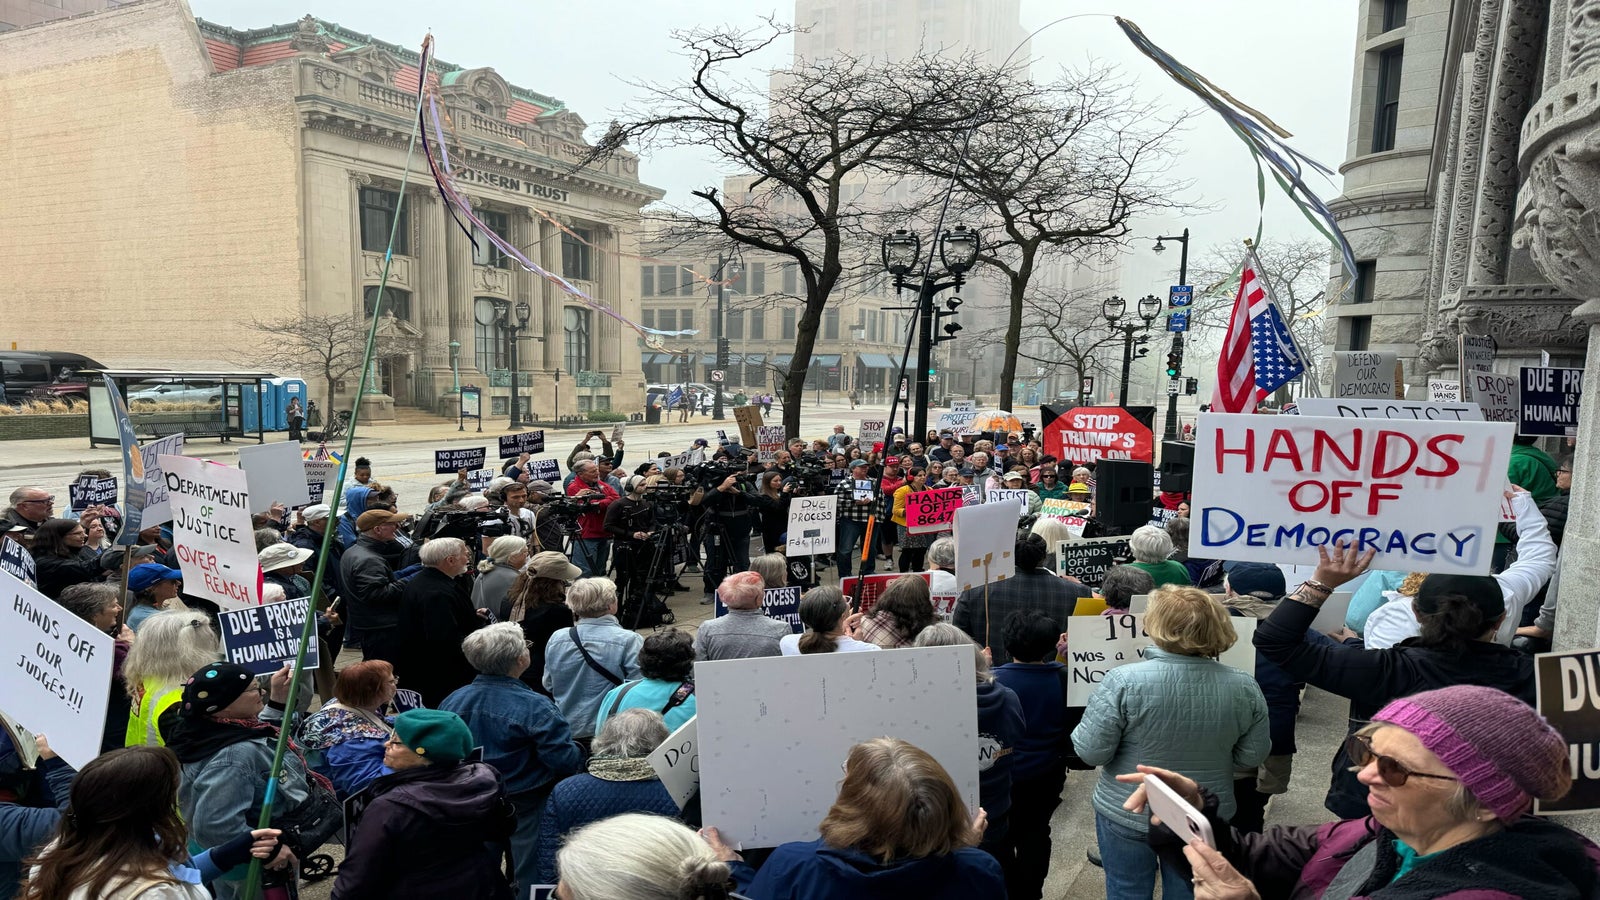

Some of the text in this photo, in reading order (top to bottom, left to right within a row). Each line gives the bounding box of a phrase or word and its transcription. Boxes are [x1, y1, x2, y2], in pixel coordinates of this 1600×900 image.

[523, 181, 569, 203] TRUST
[1172, 295, 1187, 304] 94
[1348, 353, 1382, 367] DEFEND
[1357, 367, 1378, 380] OUR
[1527, 368, 1554, 392] DUE
[1340, 383, 1391, 397] DEMOCRACY
[1477, 375, 1515, 395] DROP
[1489, 393, 1508, 405] THE
[1565, 394, 1575, 405] IS
[940, 412, 979, 421] PROTECT
[1524, 404, 1572, 422] HUMAN
[863, 421, 885, 431] STOP
[1073, 414, 1119, 430] STOP
[502, 431, 542, 445] DUE PROCESS
[1060, 429, 1135, 448] TRUMP'S
[438, 449, 483, 460] NO JUSTICE,
[501, 446, 522, 455] HUMAN
[1063, 447, 1131, 463] WAR ON
[1215, 427, 1465, 479] HANDS
[437, 461, 450, 469] NO
[530, 460, 556, 470] PROCESS
[665, 453, 692, 468] STOP
[165, 471, 248, 509] DEPARTMENT
[908, 490, 963, 506] HANDS
[1045, 499, 1089, 510] MAYDAY
[1288, 480, 1403, 516] OFF
[200, 505, 213, 519] OF
[919, 500, 957, 514] OFF!
[790, 511, 832, 523] PROCESS
[917, 511, 955, 526] 8647
[1048, 514, 1086, 526] AYDAY
[177, 507, 240, 543] JUSTICE
[1201, 507, 1476, 557] DEMOCRACY
[5, 539, 20, 558] DUE
[1068, 547, 1108, 558] HANDS
[0, 558, 25, 578] HUMAN
[1068, 557, 1089, 567] OFF
[1068, 565, 1108, 576] SOCIAL
[204, 572, 250, 604] REACH
[227, 599, 310, 636] DUE PROCESS
[764, 607, 771, 615] A
[13, 593, 96, 663] HANDS OFF
[274, 626, 293, 640] IS A
[1105, 614, 1149, 641] 19
[36, 642, 63, 677] OUR
[231, 640, 287, 665] HUMAN
[1072, 651, 1125, 662] was a
[397, 690, 418, 709] DUE
